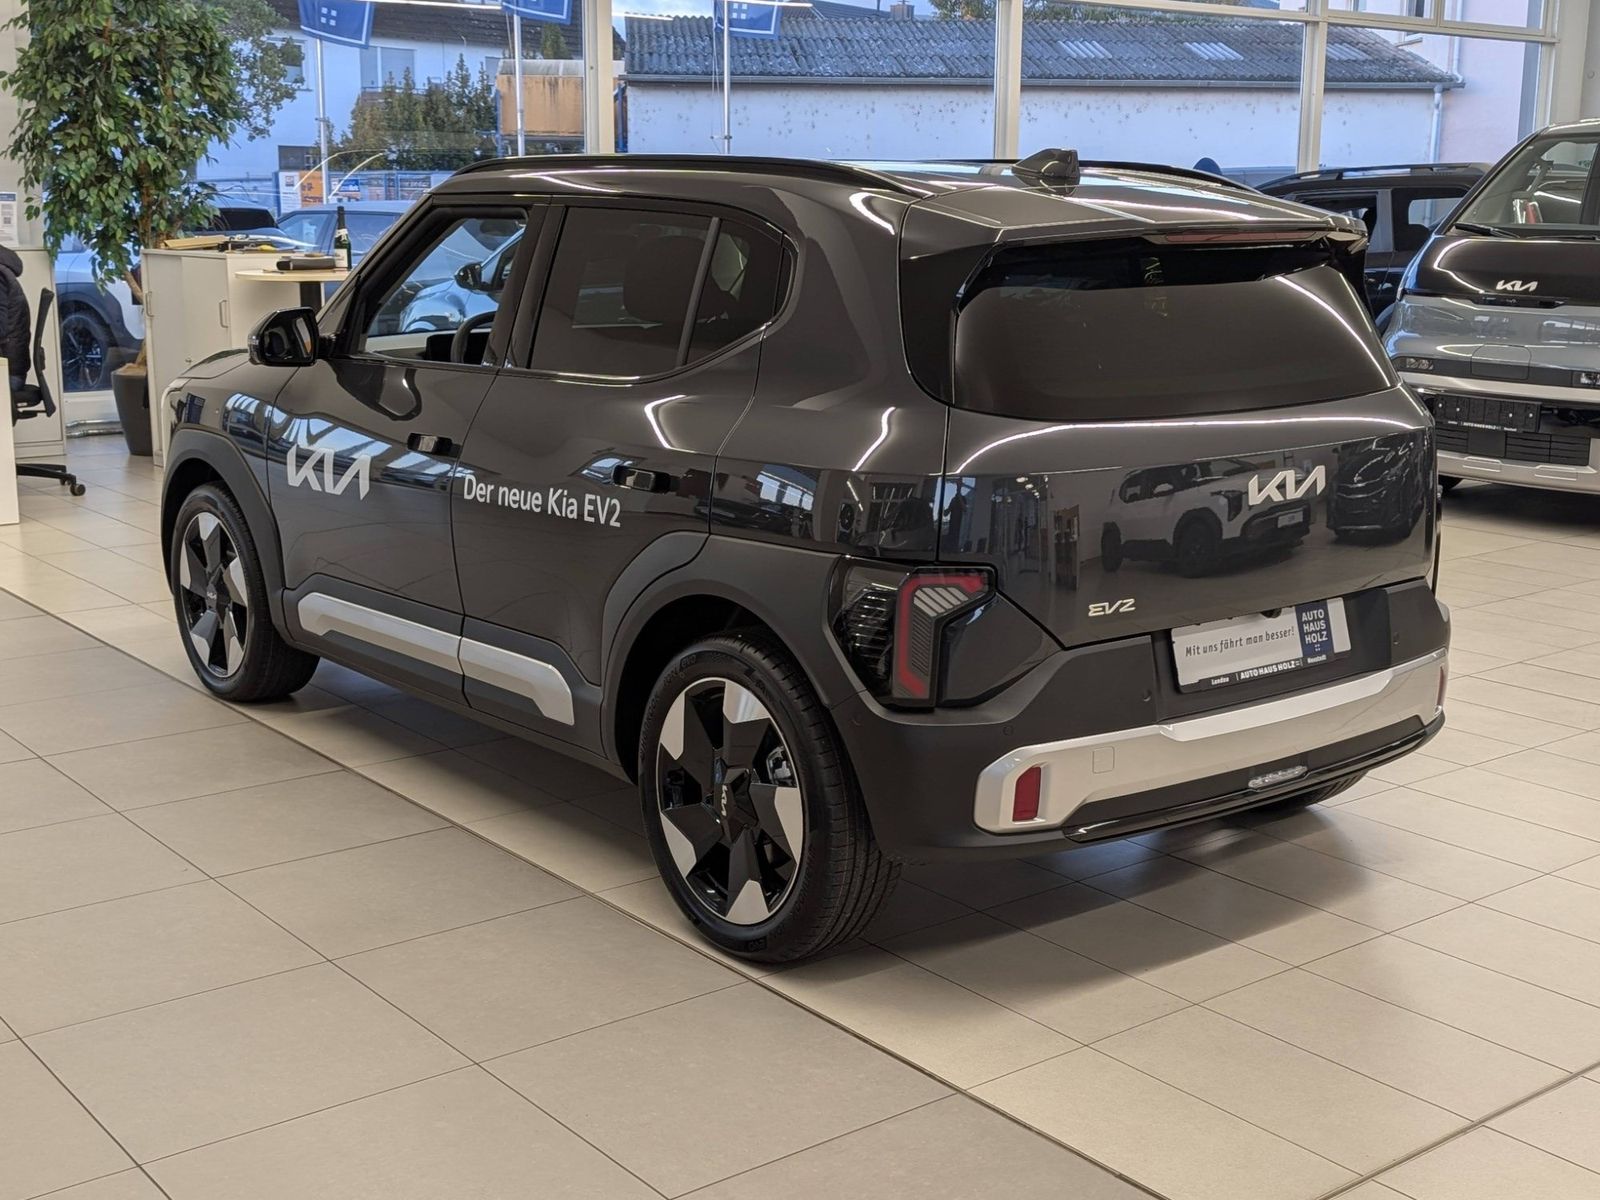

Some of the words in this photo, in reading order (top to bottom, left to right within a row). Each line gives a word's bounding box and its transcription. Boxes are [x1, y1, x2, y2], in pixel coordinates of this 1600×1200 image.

[1495, 279, 1538, 292] KIA
[286, 444, 371, 500] KIA
[1247, 464, 1327, 506] KIA
[463, 474, 494, 505] Der
[497, 486, 542, 514] neue
[547, 487, 578, 520] Kia
[583, 493, 622, 529] EV2
[1088, 598, 1136, 617] EV2
[1301, 608, 1325, 622] AUTO
[1303, 619, 1326, 632] HAUS
[1185, 643, 1200, 657] Mit
[1203, 643, 1218, 655] uns
[1219, 638, 1243, 653] fährt
[1245, 634, 1263, 645] man
[1265, 626, 1295, 641] besser!
[1304, 631, 1328, 645] HOLZ
[1240, 669, 1259, 680] AUTO
[1259, 664, 1278, 676] HAUS
[1277, 660, 1296, 672] HOLZ
